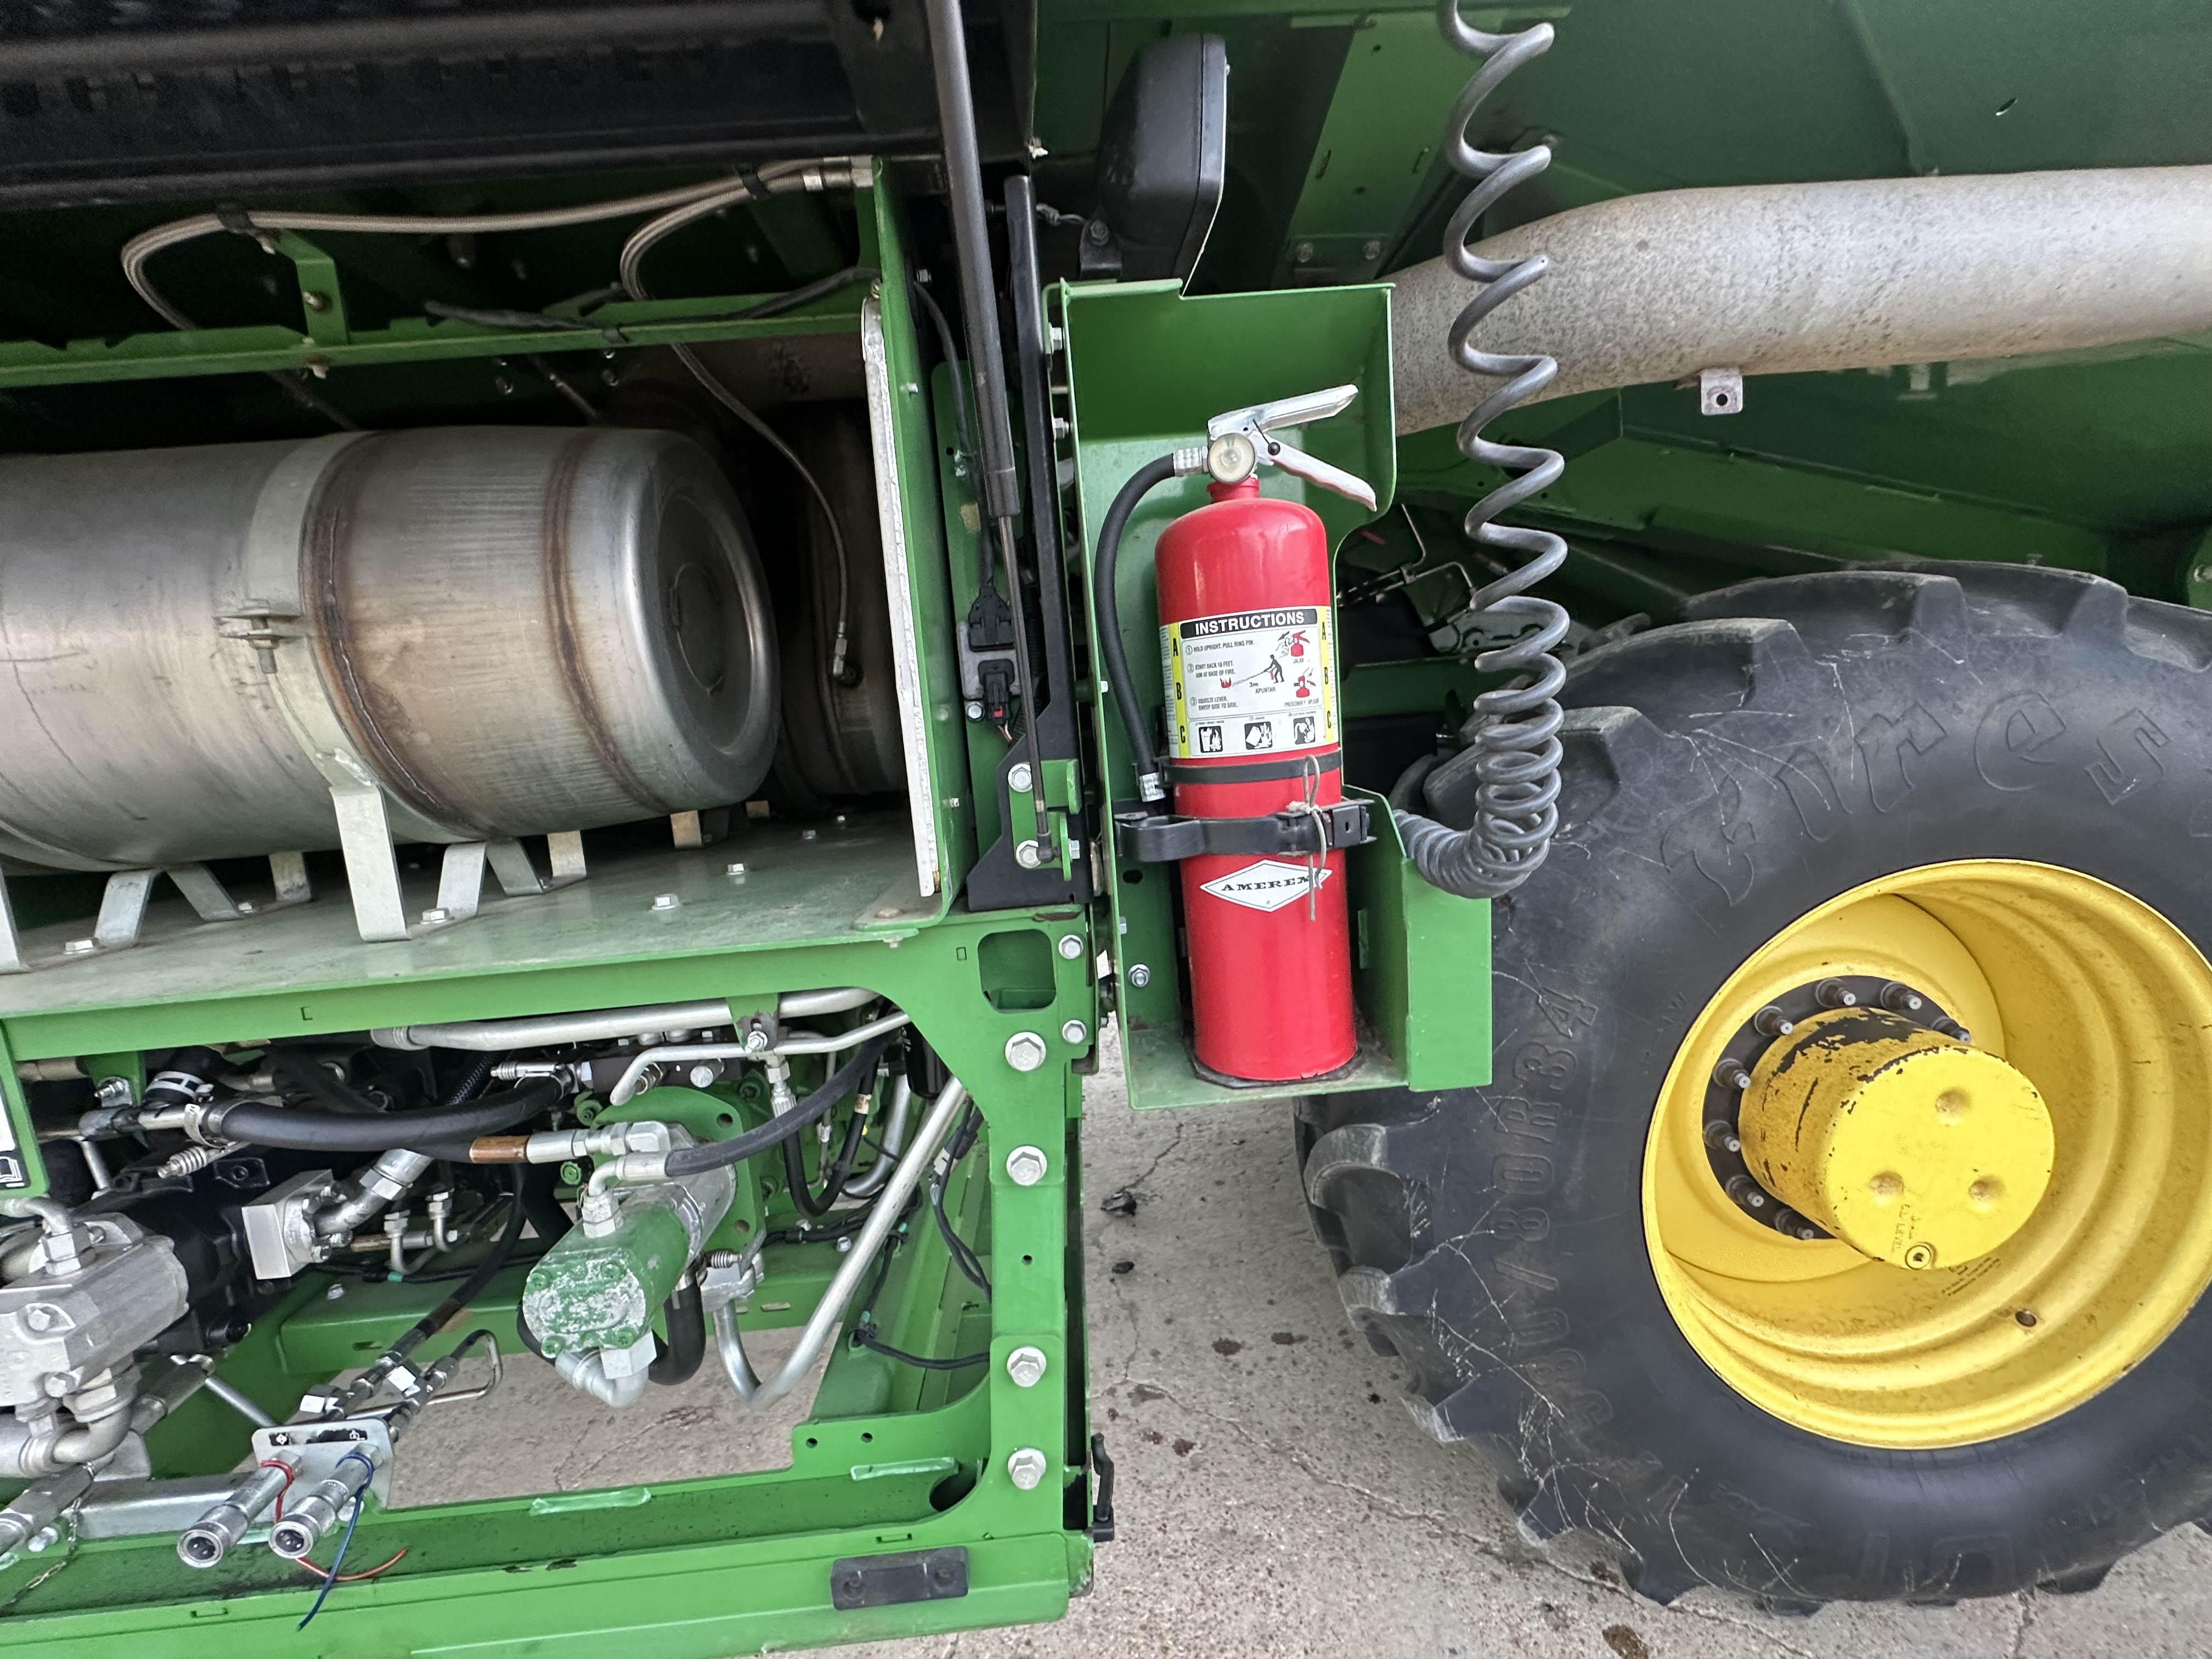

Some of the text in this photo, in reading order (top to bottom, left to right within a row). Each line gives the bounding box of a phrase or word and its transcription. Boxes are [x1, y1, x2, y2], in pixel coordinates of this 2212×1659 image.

[1195, 611, 1305, 635] INSTRUCTIONS
[1322, 622, 1326, 640] A
[1173, 638, 1178, 657] A
[1324, 667, 1329, 685] B
[1176, 682, 1182, 700] B
[1327, 710, 1331, 729] C
[1180, 725, 1186, 743] C
[1221, 875, 1310, 891] AMEREX
